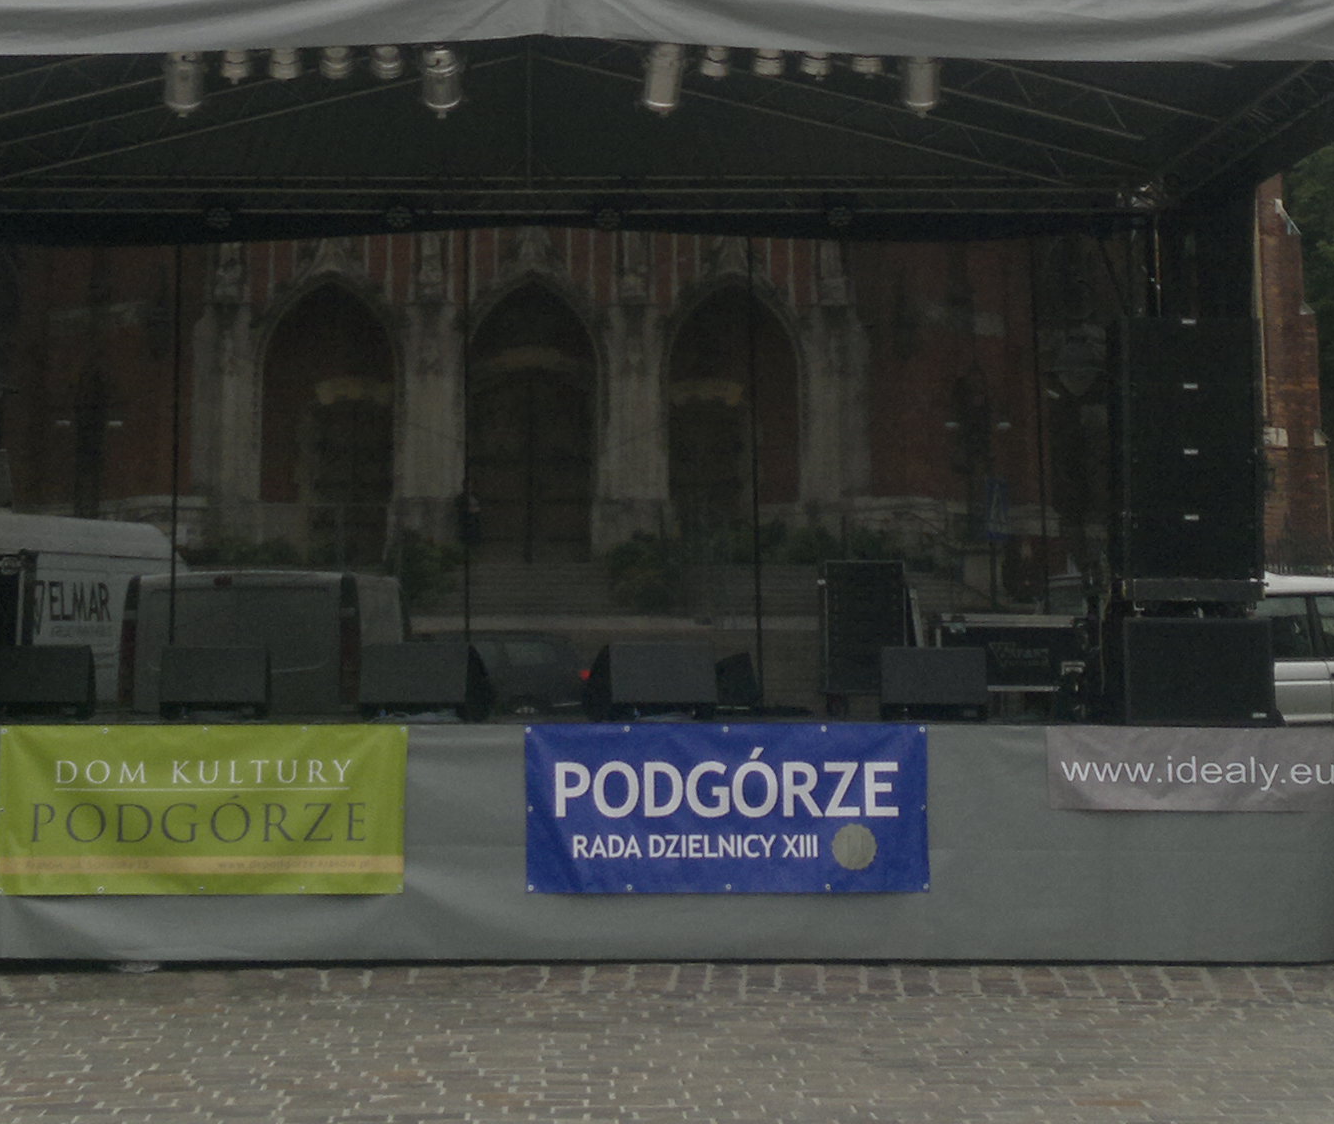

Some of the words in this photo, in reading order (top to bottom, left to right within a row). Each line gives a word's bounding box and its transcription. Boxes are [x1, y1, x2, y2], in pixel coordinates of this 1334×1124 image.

[49, 580, 112, 622] ELMAR
[54, 759, 148, 785] DOM
[171, 759, 353, 785] KULTURY
[554, 747, 900, 819] PODGÓRZE
[30, 794, 367, 844] PODGÓRZE
[572, 834, 643, 859] RADA
[648, 834, 777, 859] DZIELNICY
[781, 834, 819, 859] XIII
